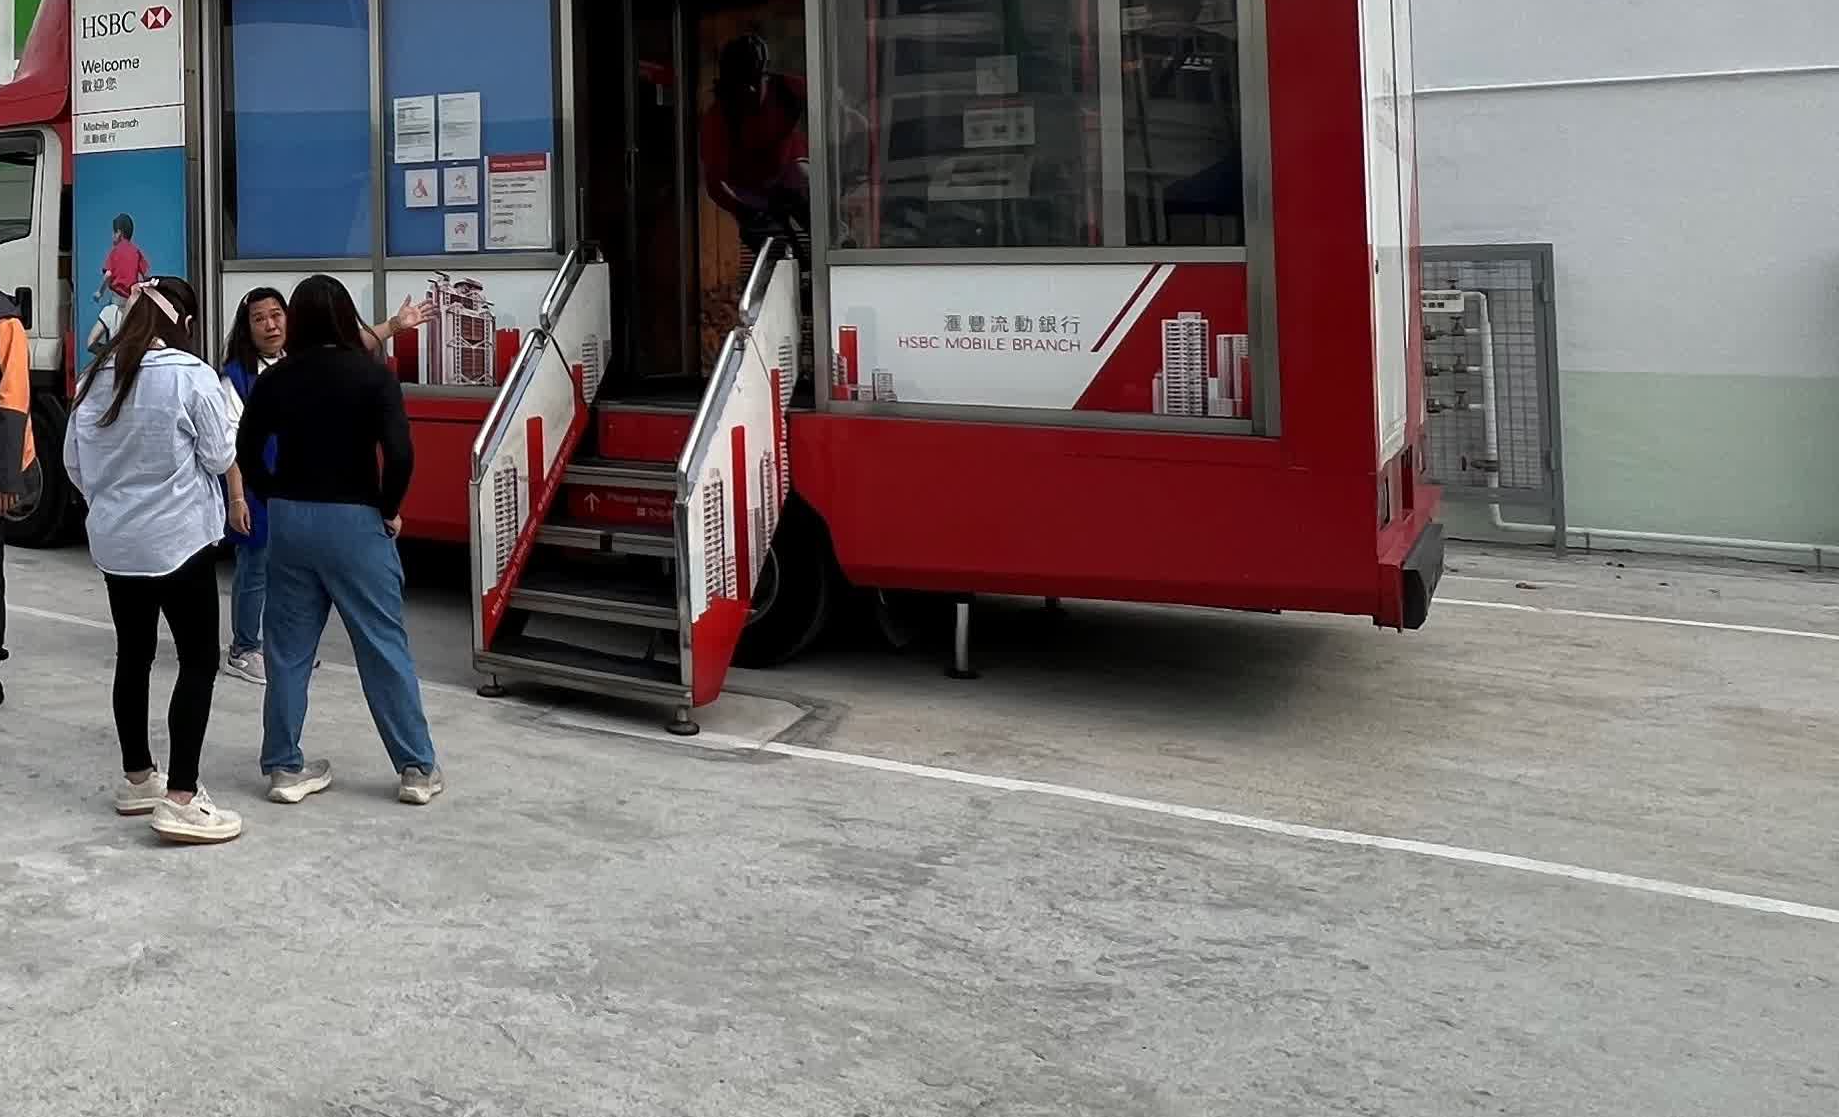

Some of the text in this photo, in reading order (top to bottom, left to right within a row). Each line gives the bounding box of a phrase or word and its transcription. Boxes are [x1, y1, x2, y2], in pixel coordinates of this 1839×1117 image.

[82, 11, 137, 39] HSBC
[81, 58, 140, 75] Welcome
[83, 118, 139, 131] Mobile Branch
[898, 336, 1081, 353] HSBC MOBILE BRANCH
